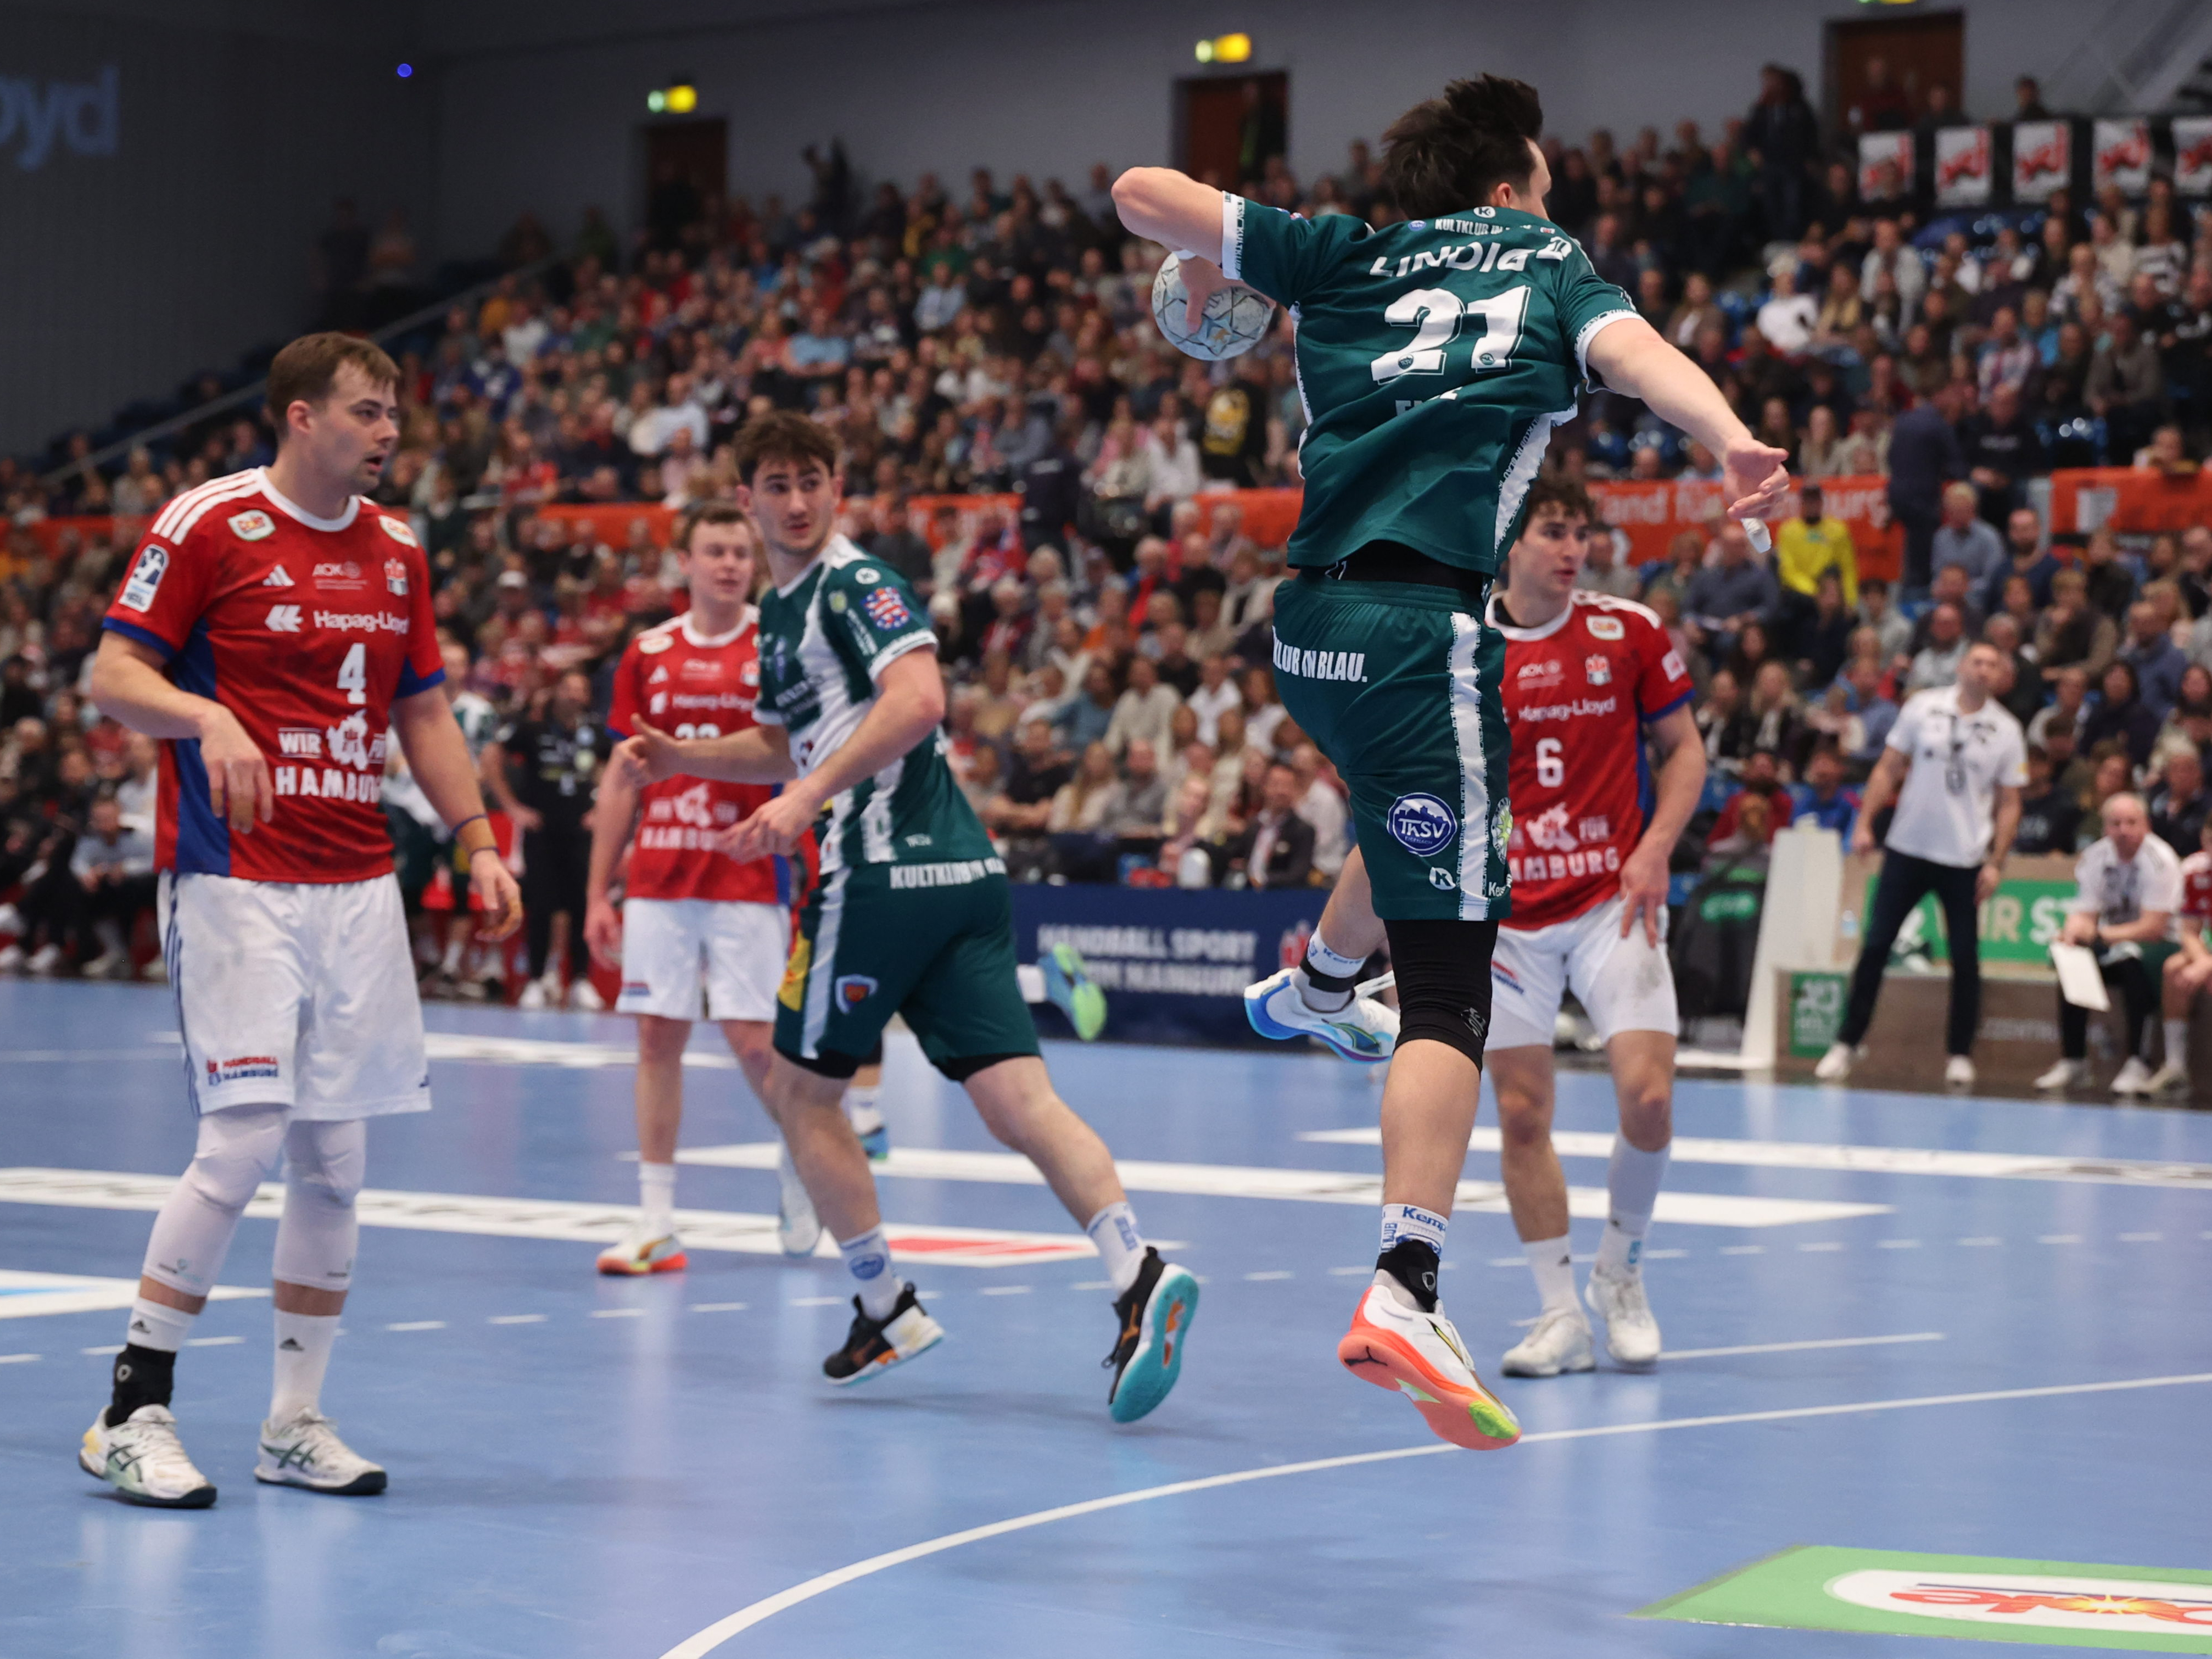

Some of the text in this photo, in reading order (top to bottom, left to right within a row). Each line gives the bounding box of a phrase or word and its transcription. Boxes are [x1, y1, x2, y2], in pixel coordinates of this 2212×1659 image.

[1370, 242, 1537, 277] LINDIG
[1371, 284, 1531, 386] 21
[337, 643, 367, 705] 4
[1302, 650, 1317, 678] IN
[1317, 651, 1368, 683] BLAU.
[278, 732, 322, 755] WIR
[1536, 737, 1564, 787] 6
[276, 766, 382, 803] HAMBU
[1403, 1206, 1446, 1231] Kemp
